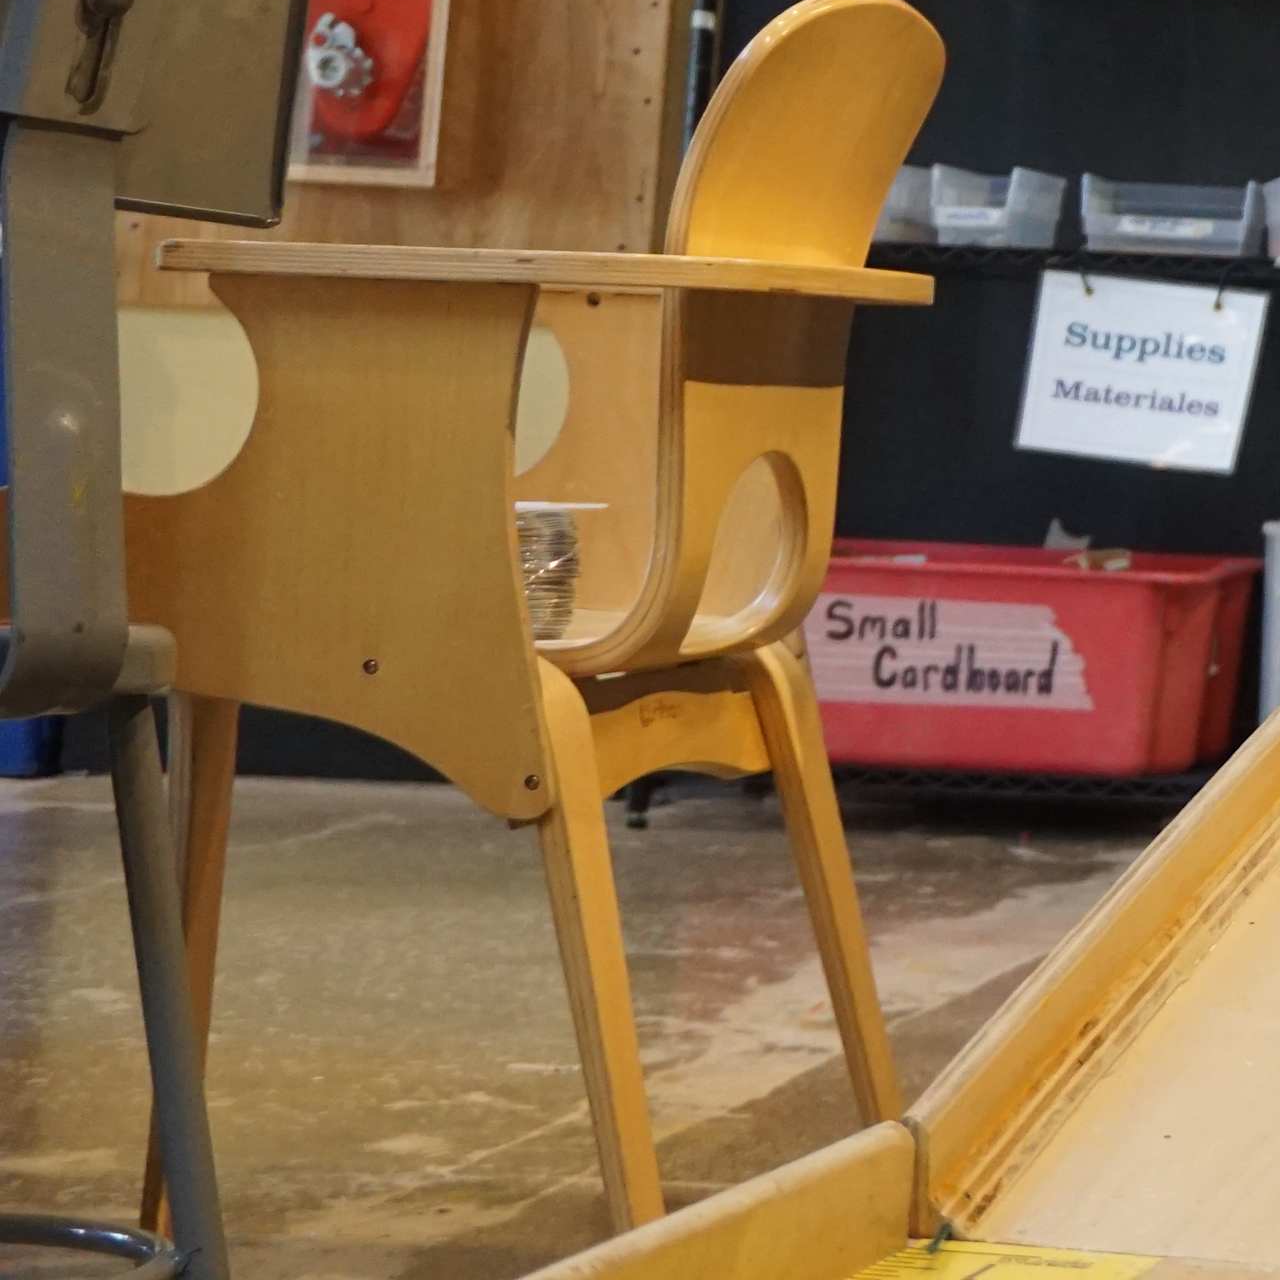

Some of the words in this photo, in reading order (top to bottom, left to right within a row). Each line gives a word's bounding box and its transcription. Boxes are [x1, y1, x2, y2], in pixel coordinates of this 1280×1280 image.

[1064, 321, 1226, 364] Supplies
[1052, 379, 1220, 417] Materiales
[825, 600, 938, 640] Small
[873, 640, 1059, 695] Cardboard
